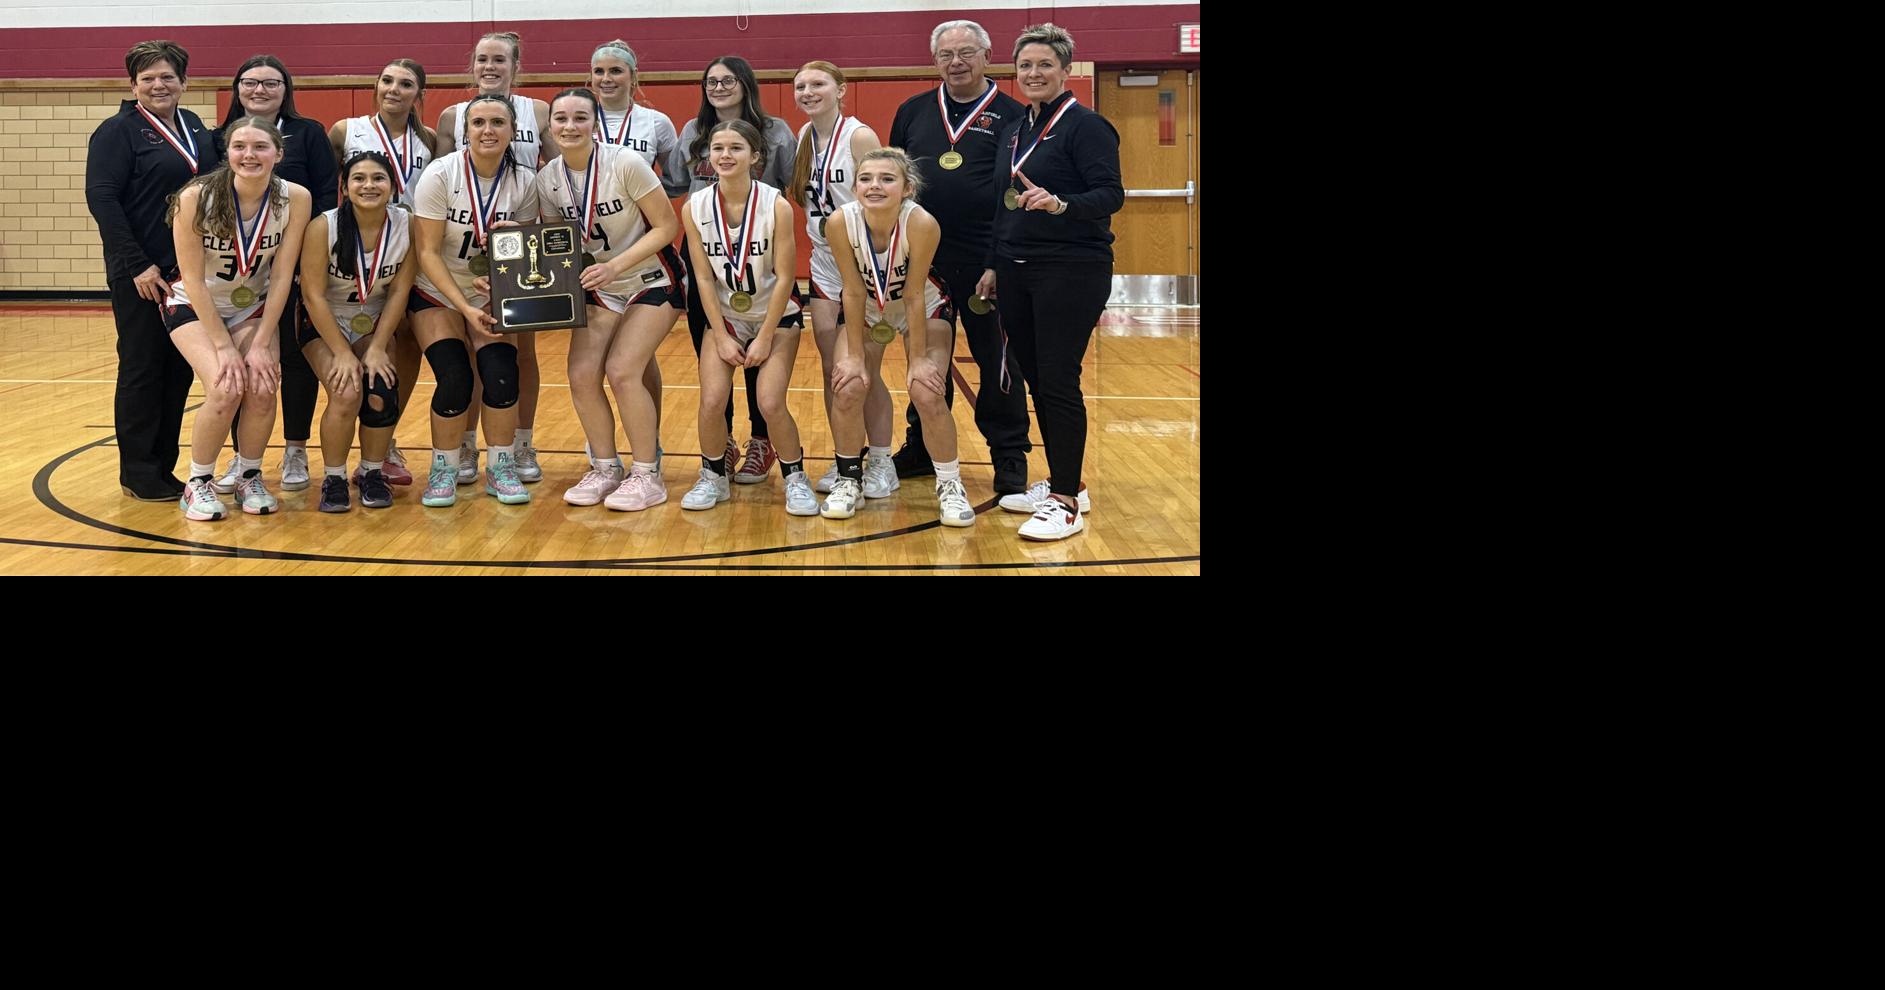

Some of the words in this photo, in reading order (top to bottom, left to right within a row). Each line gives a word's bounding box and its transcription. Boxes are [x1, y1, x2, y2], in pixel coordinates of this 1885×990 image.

[590, 223, 611, 251] 4
[216, 254, 263, 281] 34
[723, 262, 756, 295] 10
